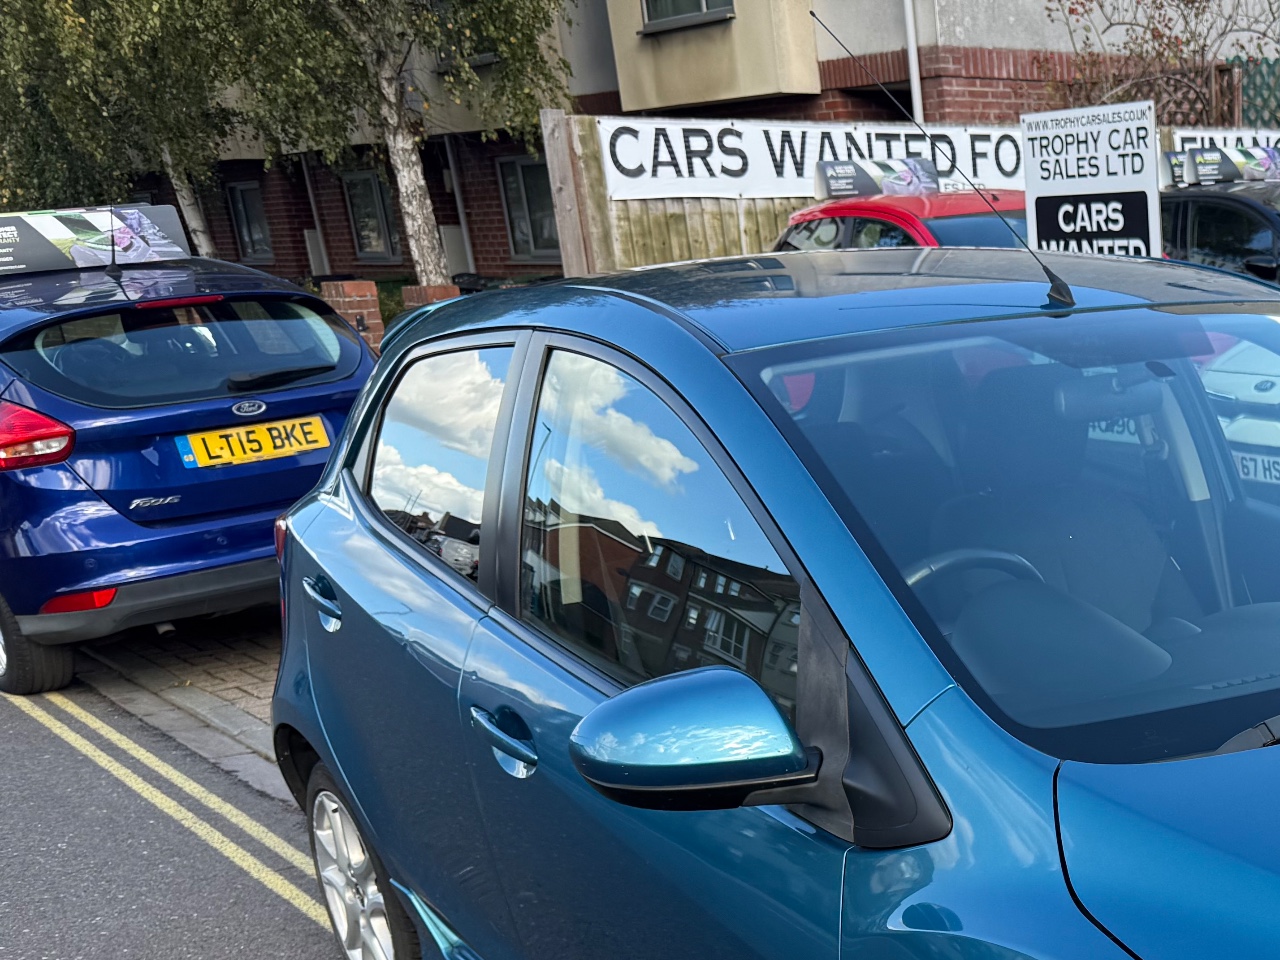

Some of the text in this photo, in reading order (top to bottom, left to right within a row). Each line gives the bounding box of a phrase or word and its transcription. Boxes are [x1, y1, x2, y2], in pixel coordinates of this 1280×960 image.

[609, 126, 749, 178] CARS
[970, 133, 1021, 178] FO
[1028, 126, 1149, 158] TROPHY CAR
[1040, 156, 1100, 181] SALES
[1106, 152, 1145, 177] LTD
[1058, 201, 1125, 233] CARS
[201, 421, 319, 461] LT15 BKE
[1239, 455, 1258, 478] 67
